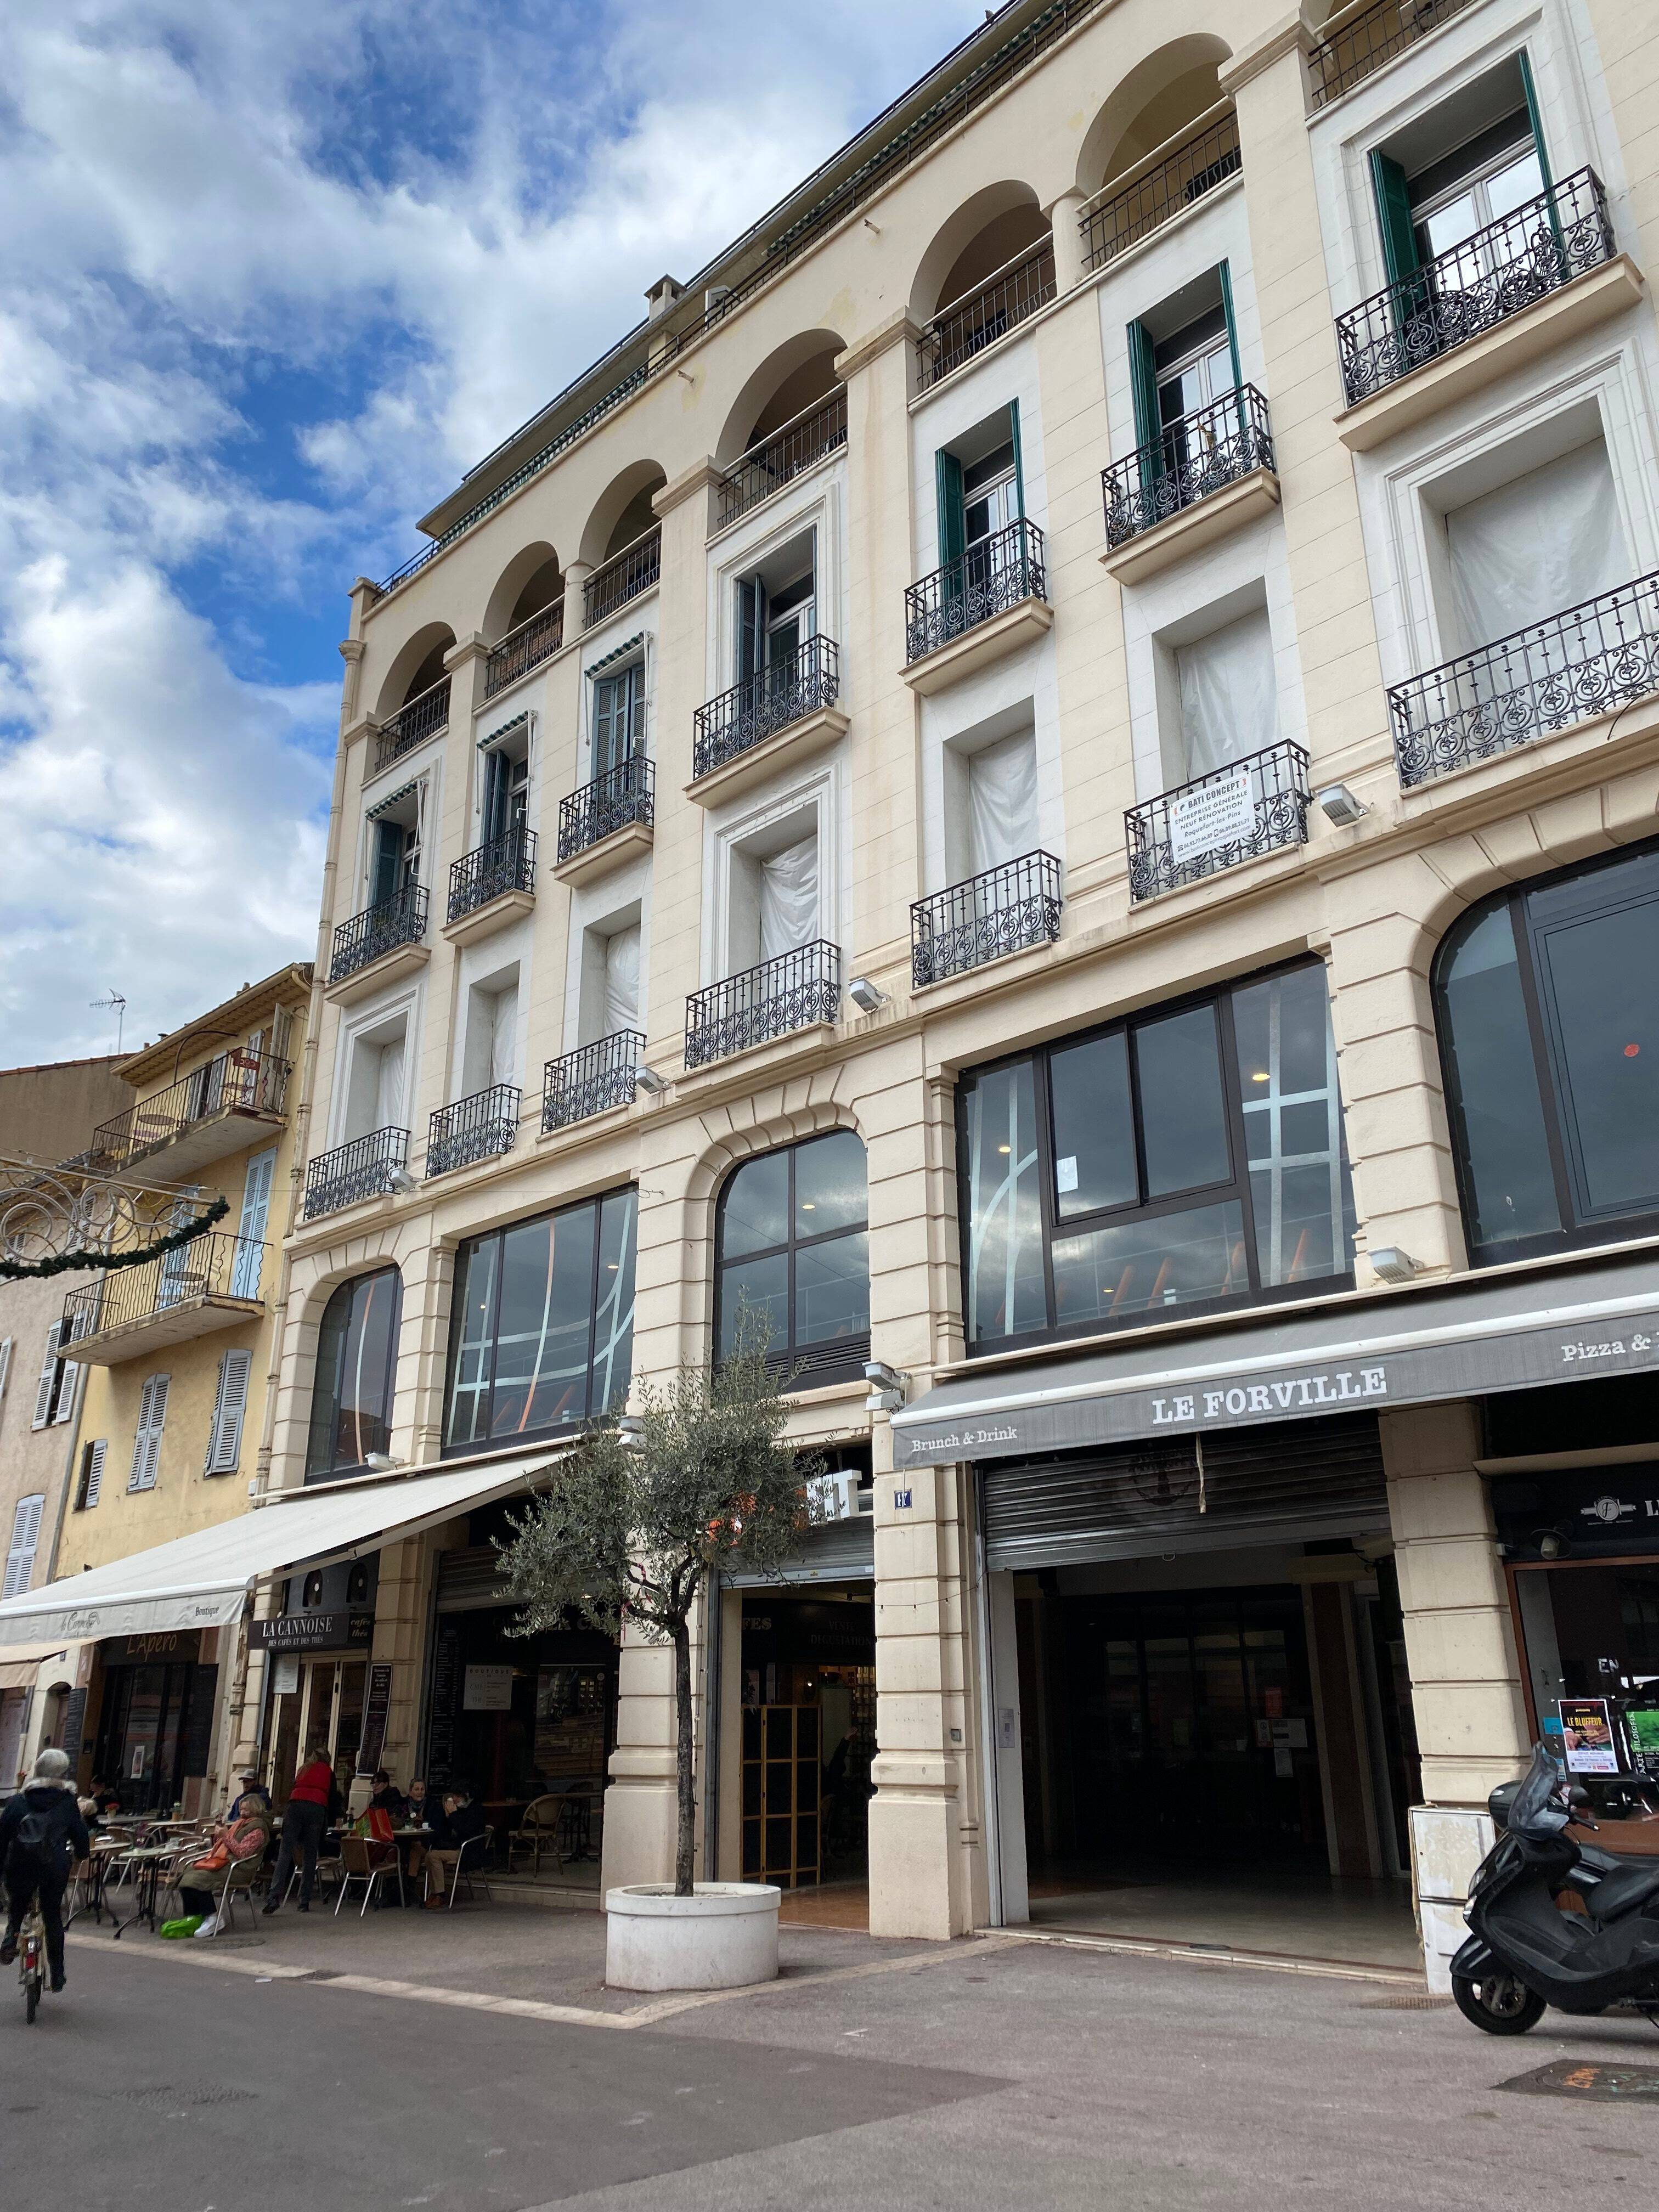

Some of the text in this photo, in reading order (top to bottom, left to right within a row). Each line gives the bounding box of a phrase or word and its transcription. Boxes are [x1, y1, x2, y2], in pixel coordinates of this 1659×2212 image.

[1188, 780, 1240, 809] BATI CONCEPT
[1175, 803, 1211, 825] ENTREPRISE
[1180, 819, 1197, 830] NEUF
[1561, 1334, 1651, 1362] Pizza &
[1152, 1367, 1387, 1425] LE FORVILLE
[912, 1426, 1018, 1452] Brunch & Drink
[1644, 1499, 1659, 1516] L
[195, 1605, 220, 1617] Boutique
[262, 1616, 332, 1638] LA CANNOISE
[301, 1637, 310, 1645] DES
[1567, 1717, 1603, 1726] LE BLUFFEUR
